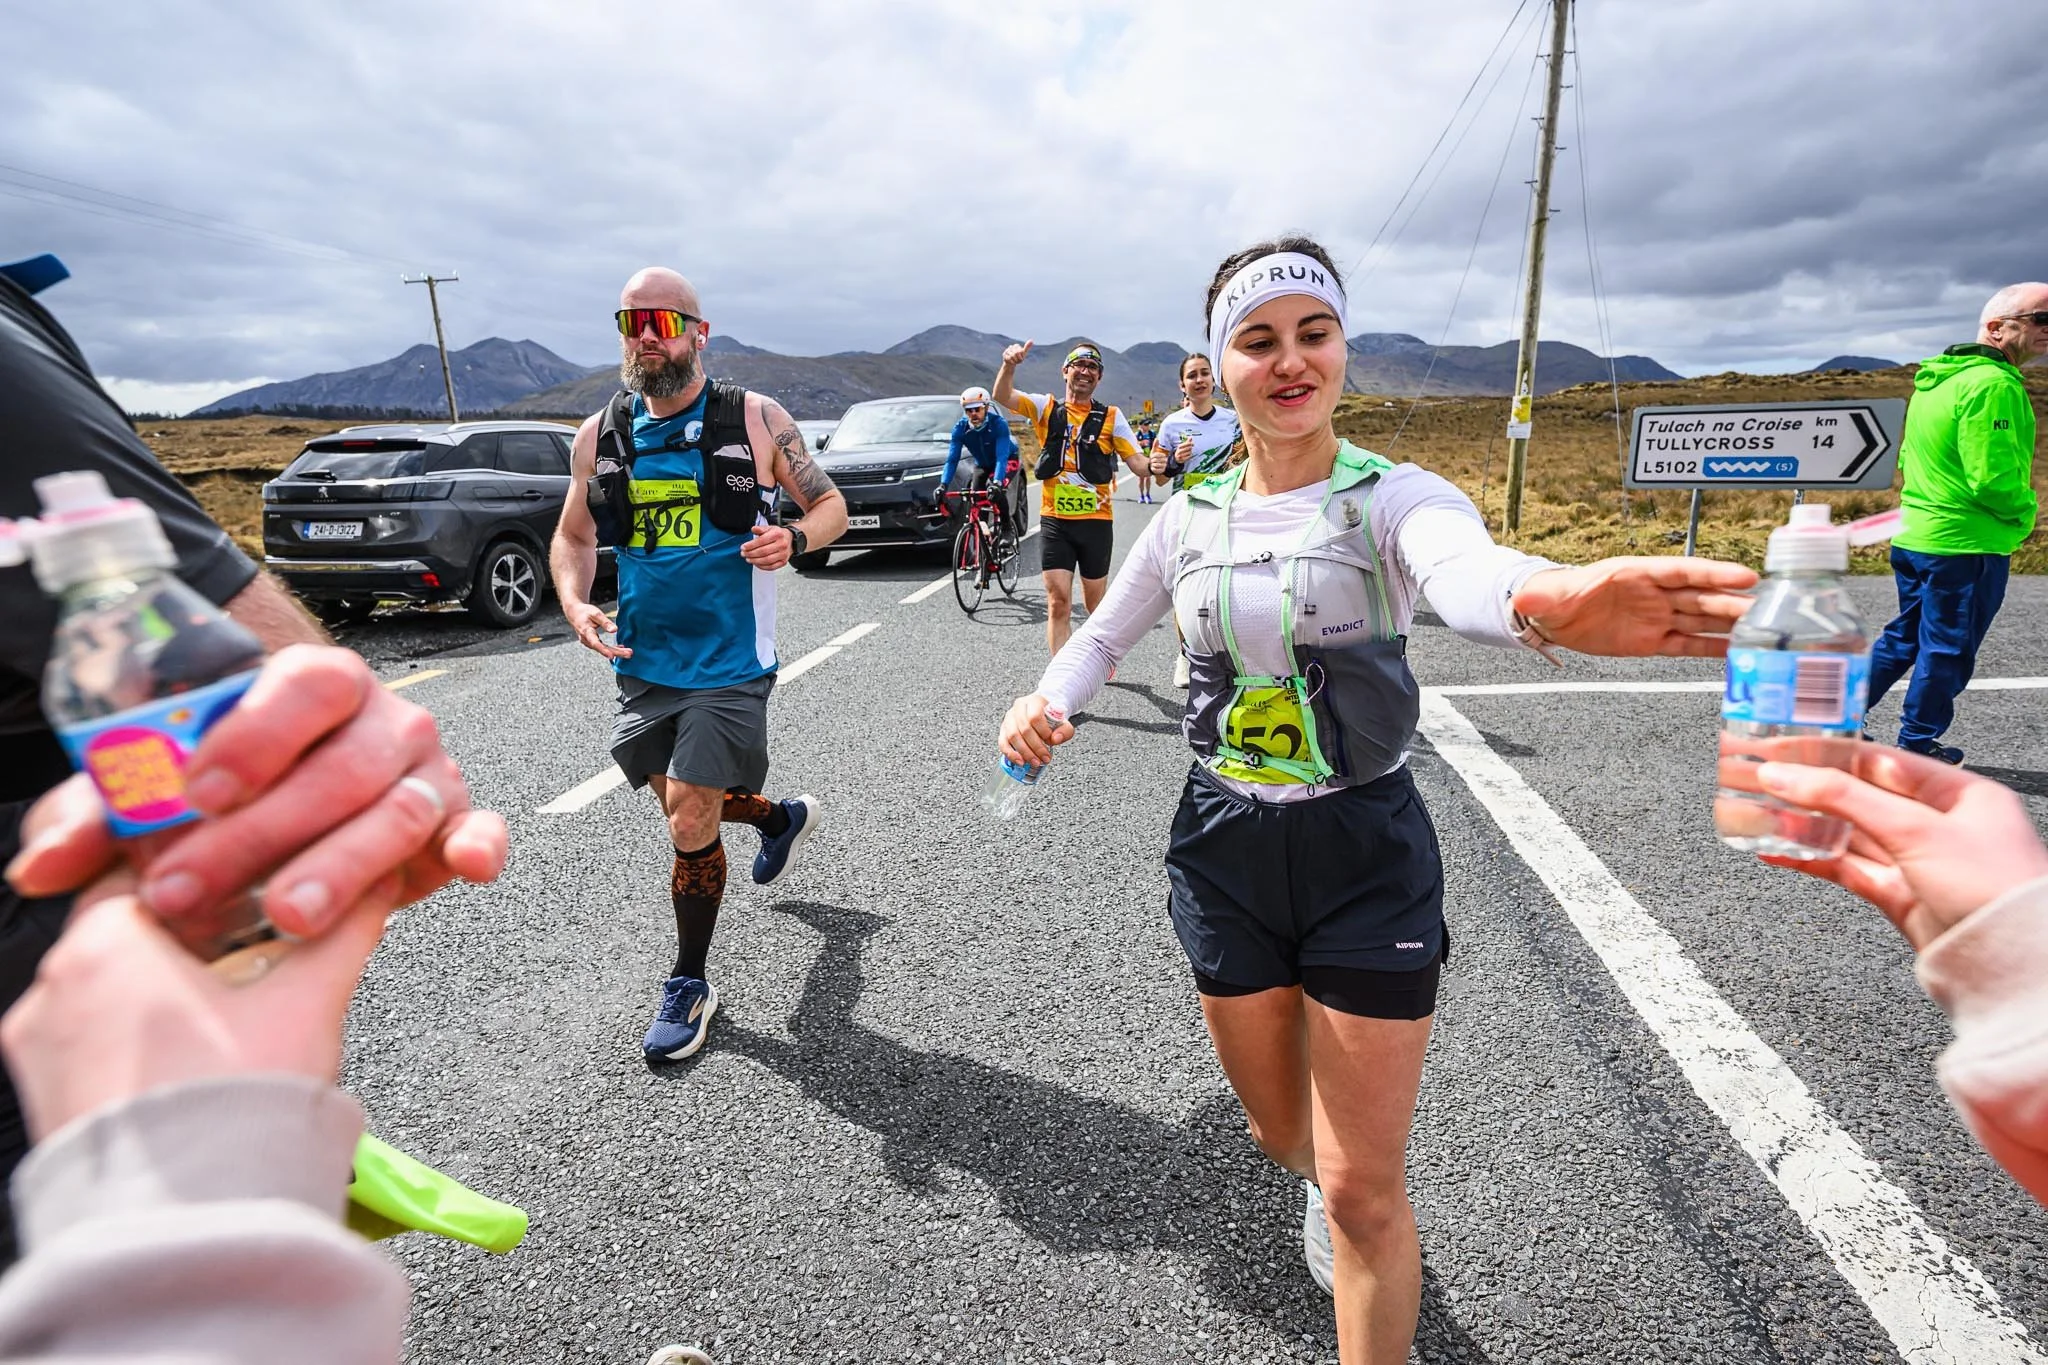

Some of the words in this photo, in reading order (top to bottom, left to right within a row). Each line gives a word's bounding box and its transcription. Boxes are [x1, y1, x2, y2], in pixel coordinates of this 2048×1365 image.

[1226, 265, 1325, 308] KIPRUN
[1648, 420, 1705, 433] Tulach
[1712, 421, 1735, 432] na
[1742, 417, 1803, 431] Croise
[1815, 416, 1838, 427] km
[1645, 436, 1775, 451] TULLYCROSS
[1812, 434, 1835, 449] 14
[1643, 461, 1697, 474] L5102
[1057, 496, 1094, 512] 5535
[1322, 619, 1365, 636] EVADICT
